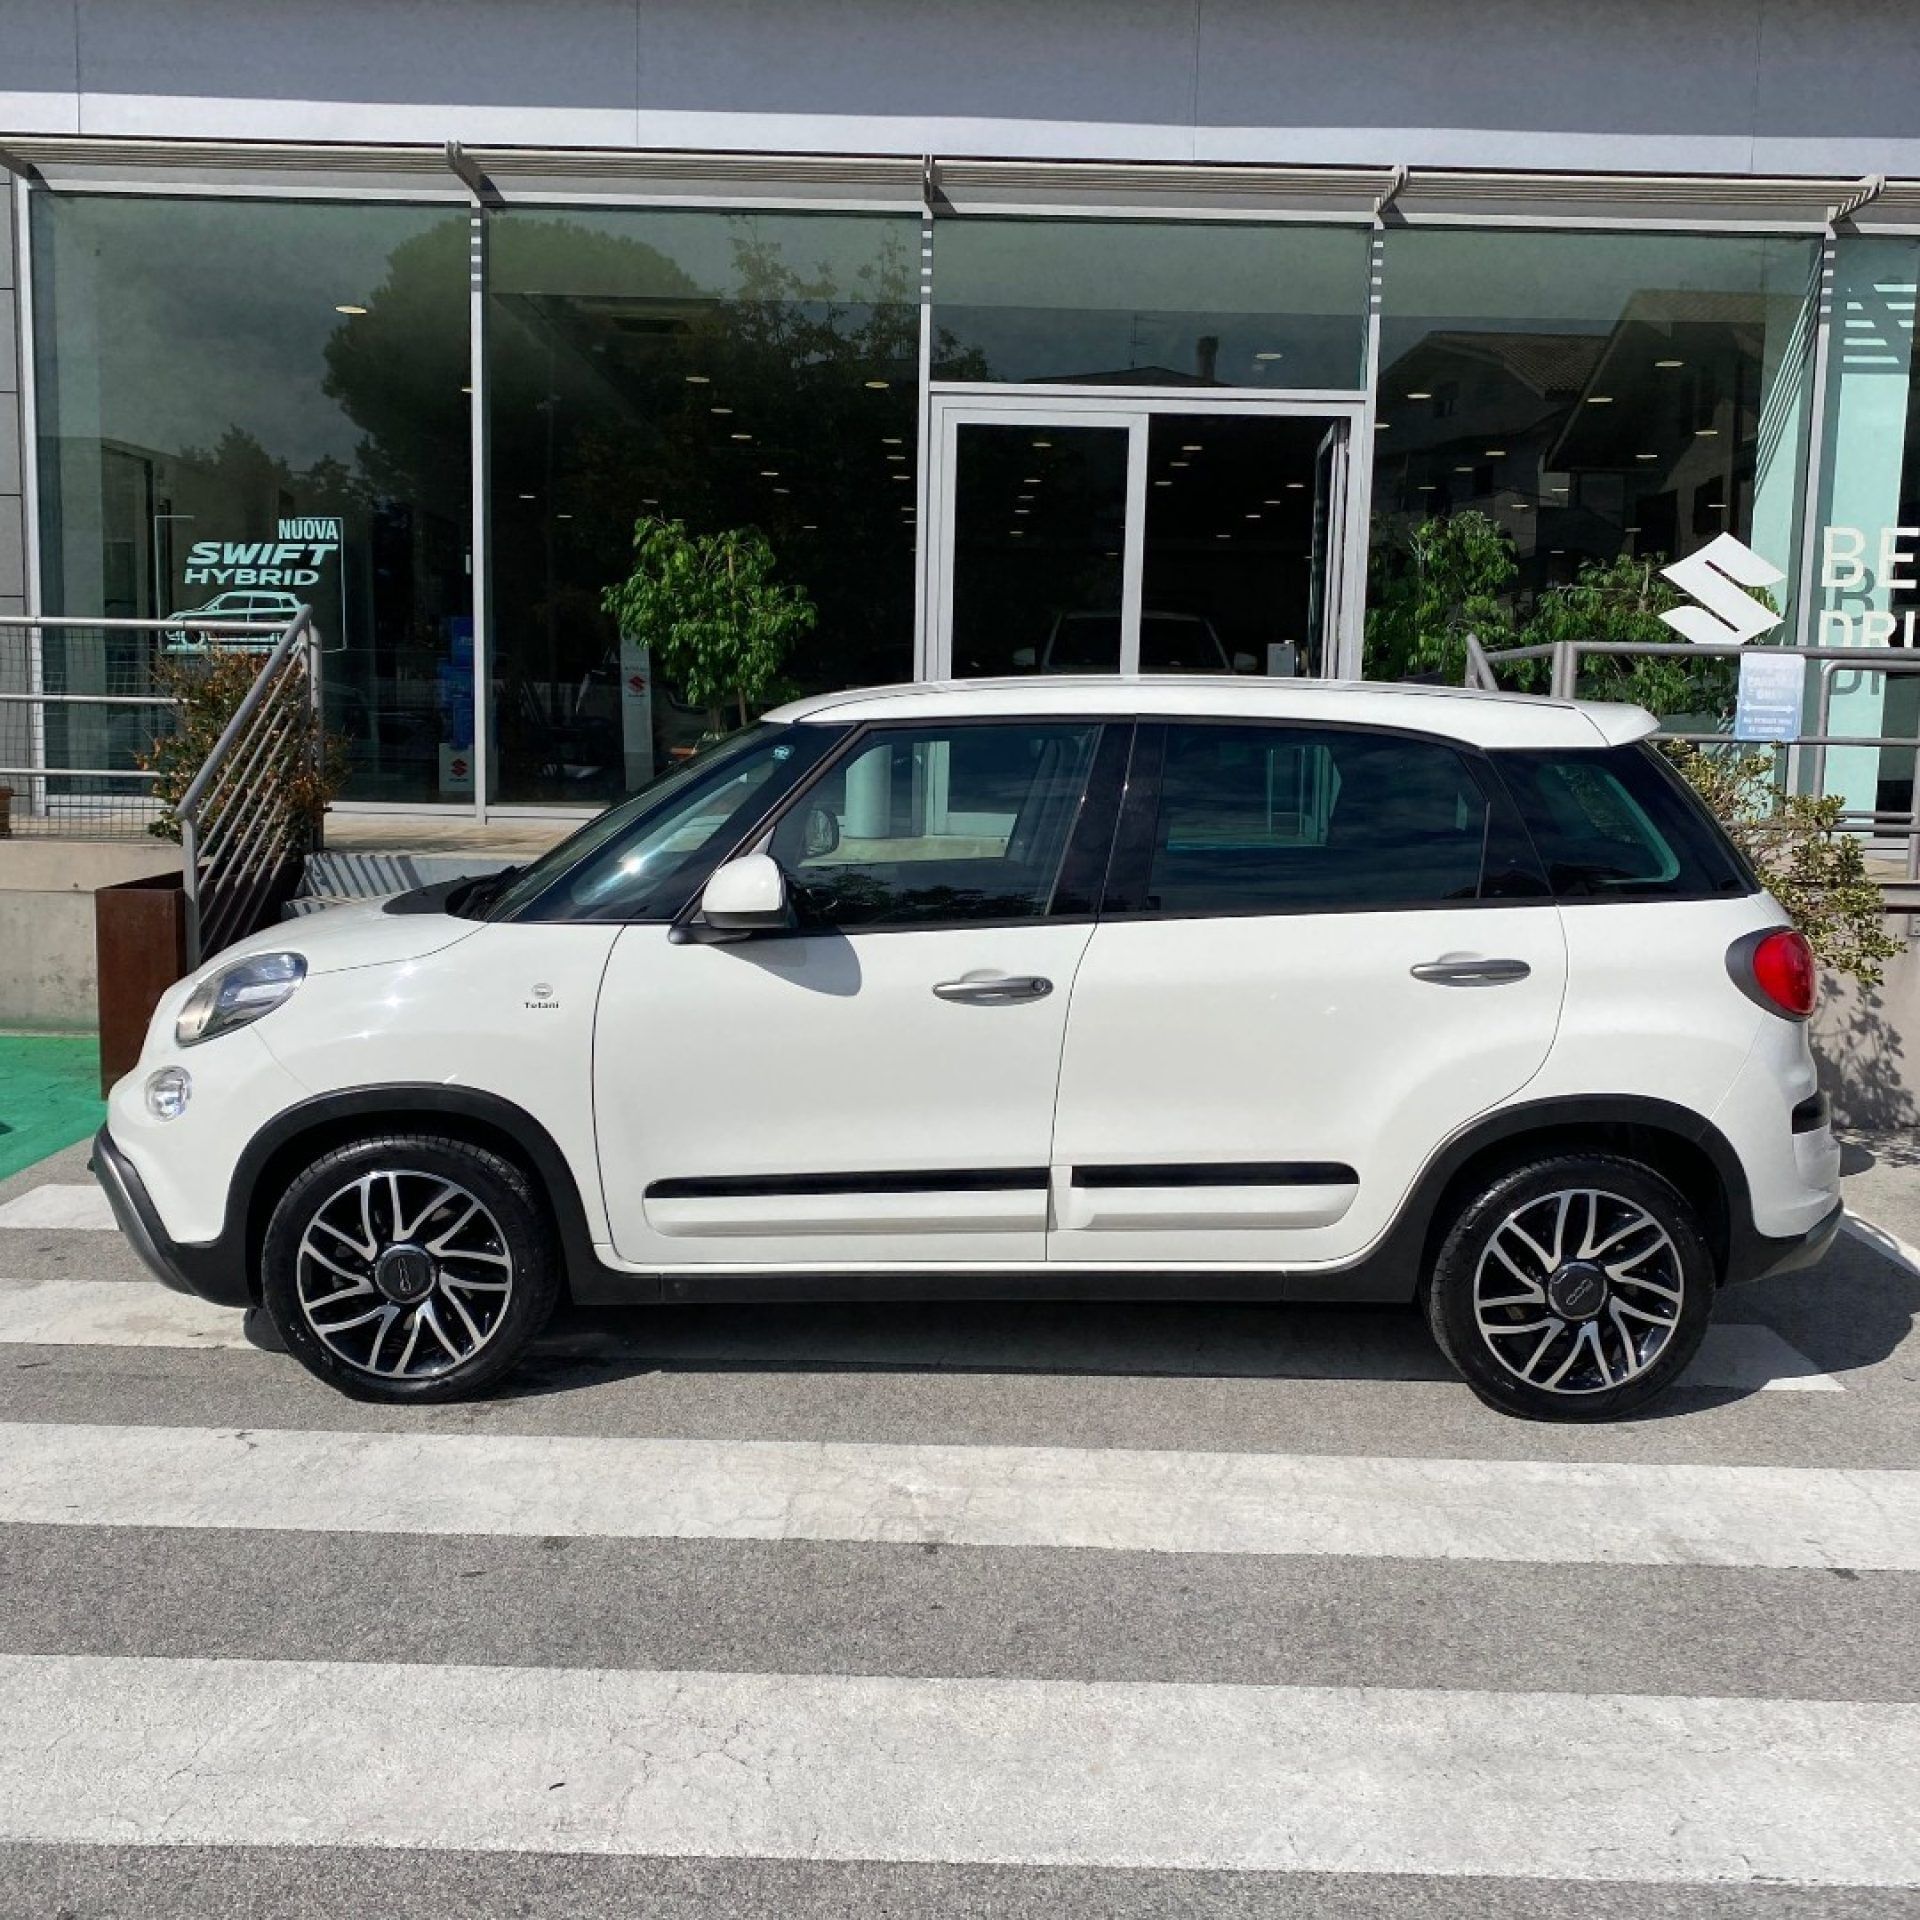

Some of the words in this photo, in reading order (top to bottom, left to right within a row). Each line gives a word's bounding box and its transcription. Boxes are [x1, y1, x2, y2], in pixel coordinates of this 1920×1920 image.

[278, 518, 339, 540] NUOVA
[186, 541, 339, 566] SWIFT
[184, 568, 320, 586] HYBRID
